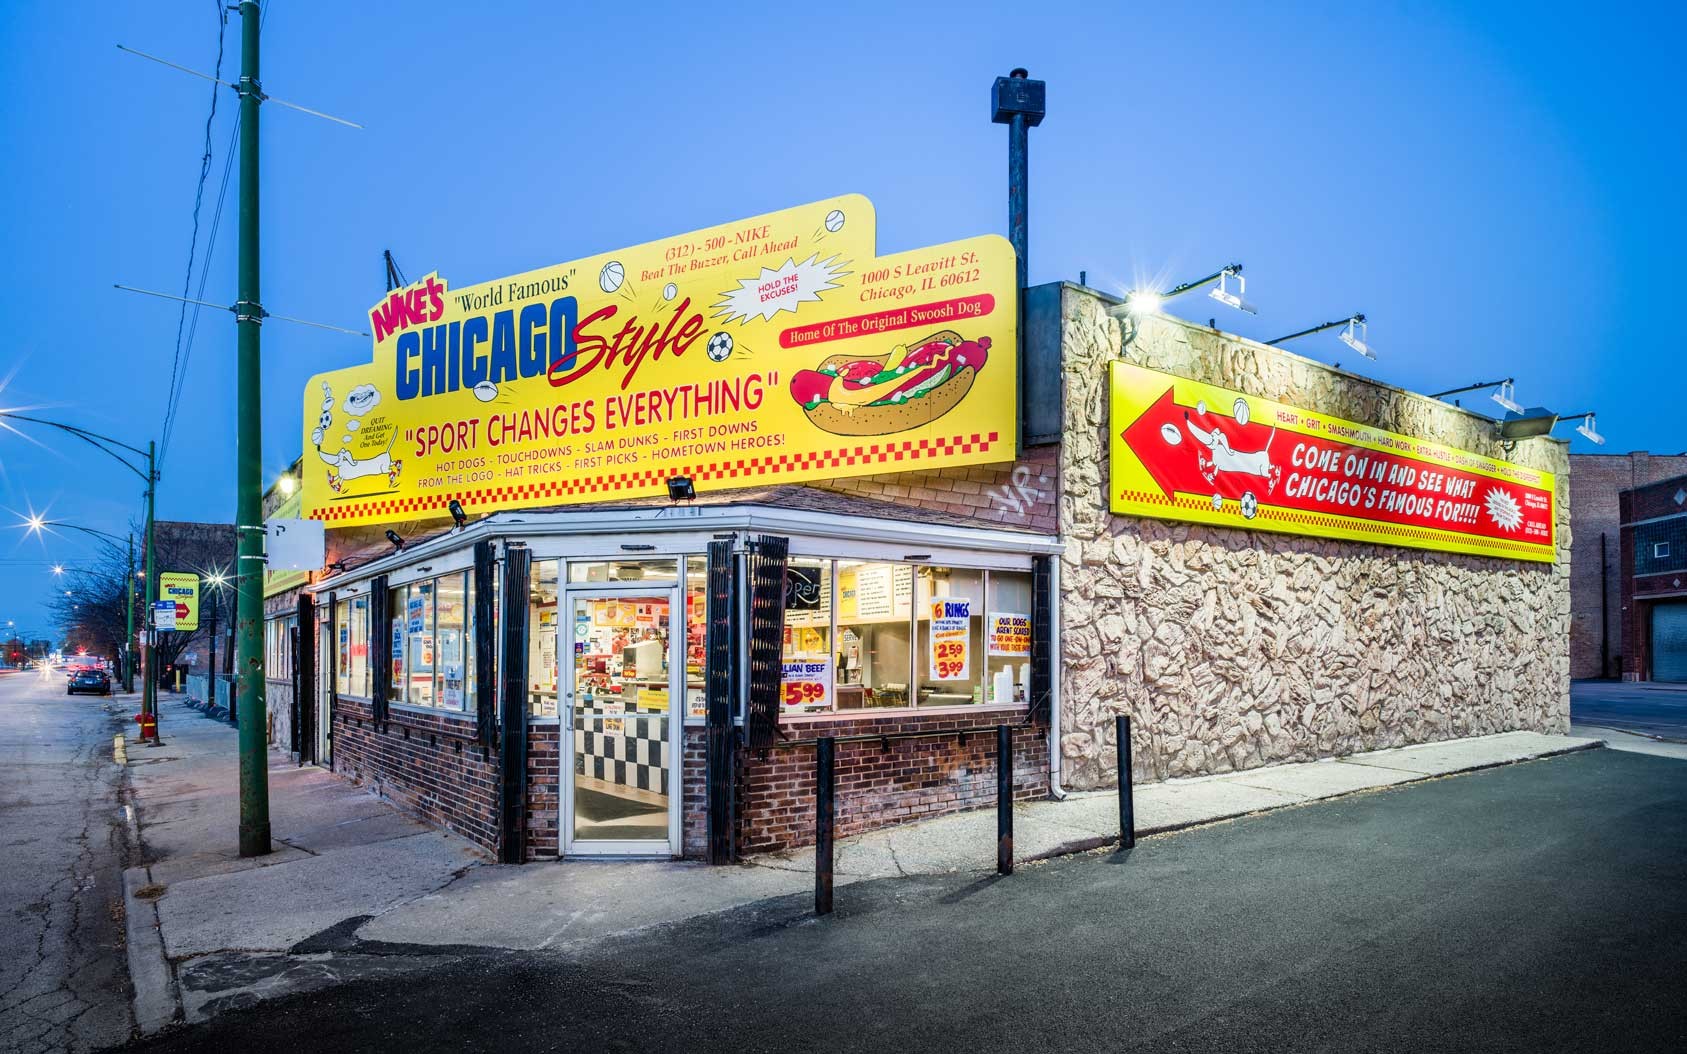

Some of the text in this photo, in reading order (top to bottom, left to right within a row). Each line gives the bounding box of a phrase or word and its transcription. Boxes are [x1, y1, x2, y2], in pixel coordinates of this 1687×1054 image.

[640, 236, 798, 282] Beat The Buzzer, Call Ahead
[666, 225, 770, 262] (312) 500 NIKE
[758, 274, 799, 293] HOLD THE
[860, 269, 980, 302] Chicago, IL 60612
[861, 252, 978, 285] 1000 S Leavitt St.
[455, 270, 576, 312] "World Famous"
[760, 284, 798, 302] EXCUSES!
[791, 301, 981, 342] Home Of The Original Swoosh Dog
[396, 296, 709, 400] CHICAGO Style
[406, 371, 778, 458] "SPORT CHANGES EVERYTHING"
[1277, 411, 1298, 425] HEART
[1306, 418, 1320, 430] GRIT
[1378, 436, 1393, 448] HARD
[1395, 440, 1410, 451] WORK
[418, 434, 785, 489] FROM THE LOGO HAT TRICKS FIRST PICKS HOMETOWN HEROES!
[436, 420, 758, 472] HOT DOGS TOUCHDOWNS SLAM DUNKS FIRST DOWNS
[1292, 443, 1476, 498] COME ON IN AND SEE WHAT
[1286, 472, 1376, 508] CHICAGO'S
[1378, 490, 1434, 517] FAMOUS
[935, 602, 969, 618] 6 RINGS
[999, 618, 1027, 626] OUR DOGS
[806, 664, 825, 673] BEEF
